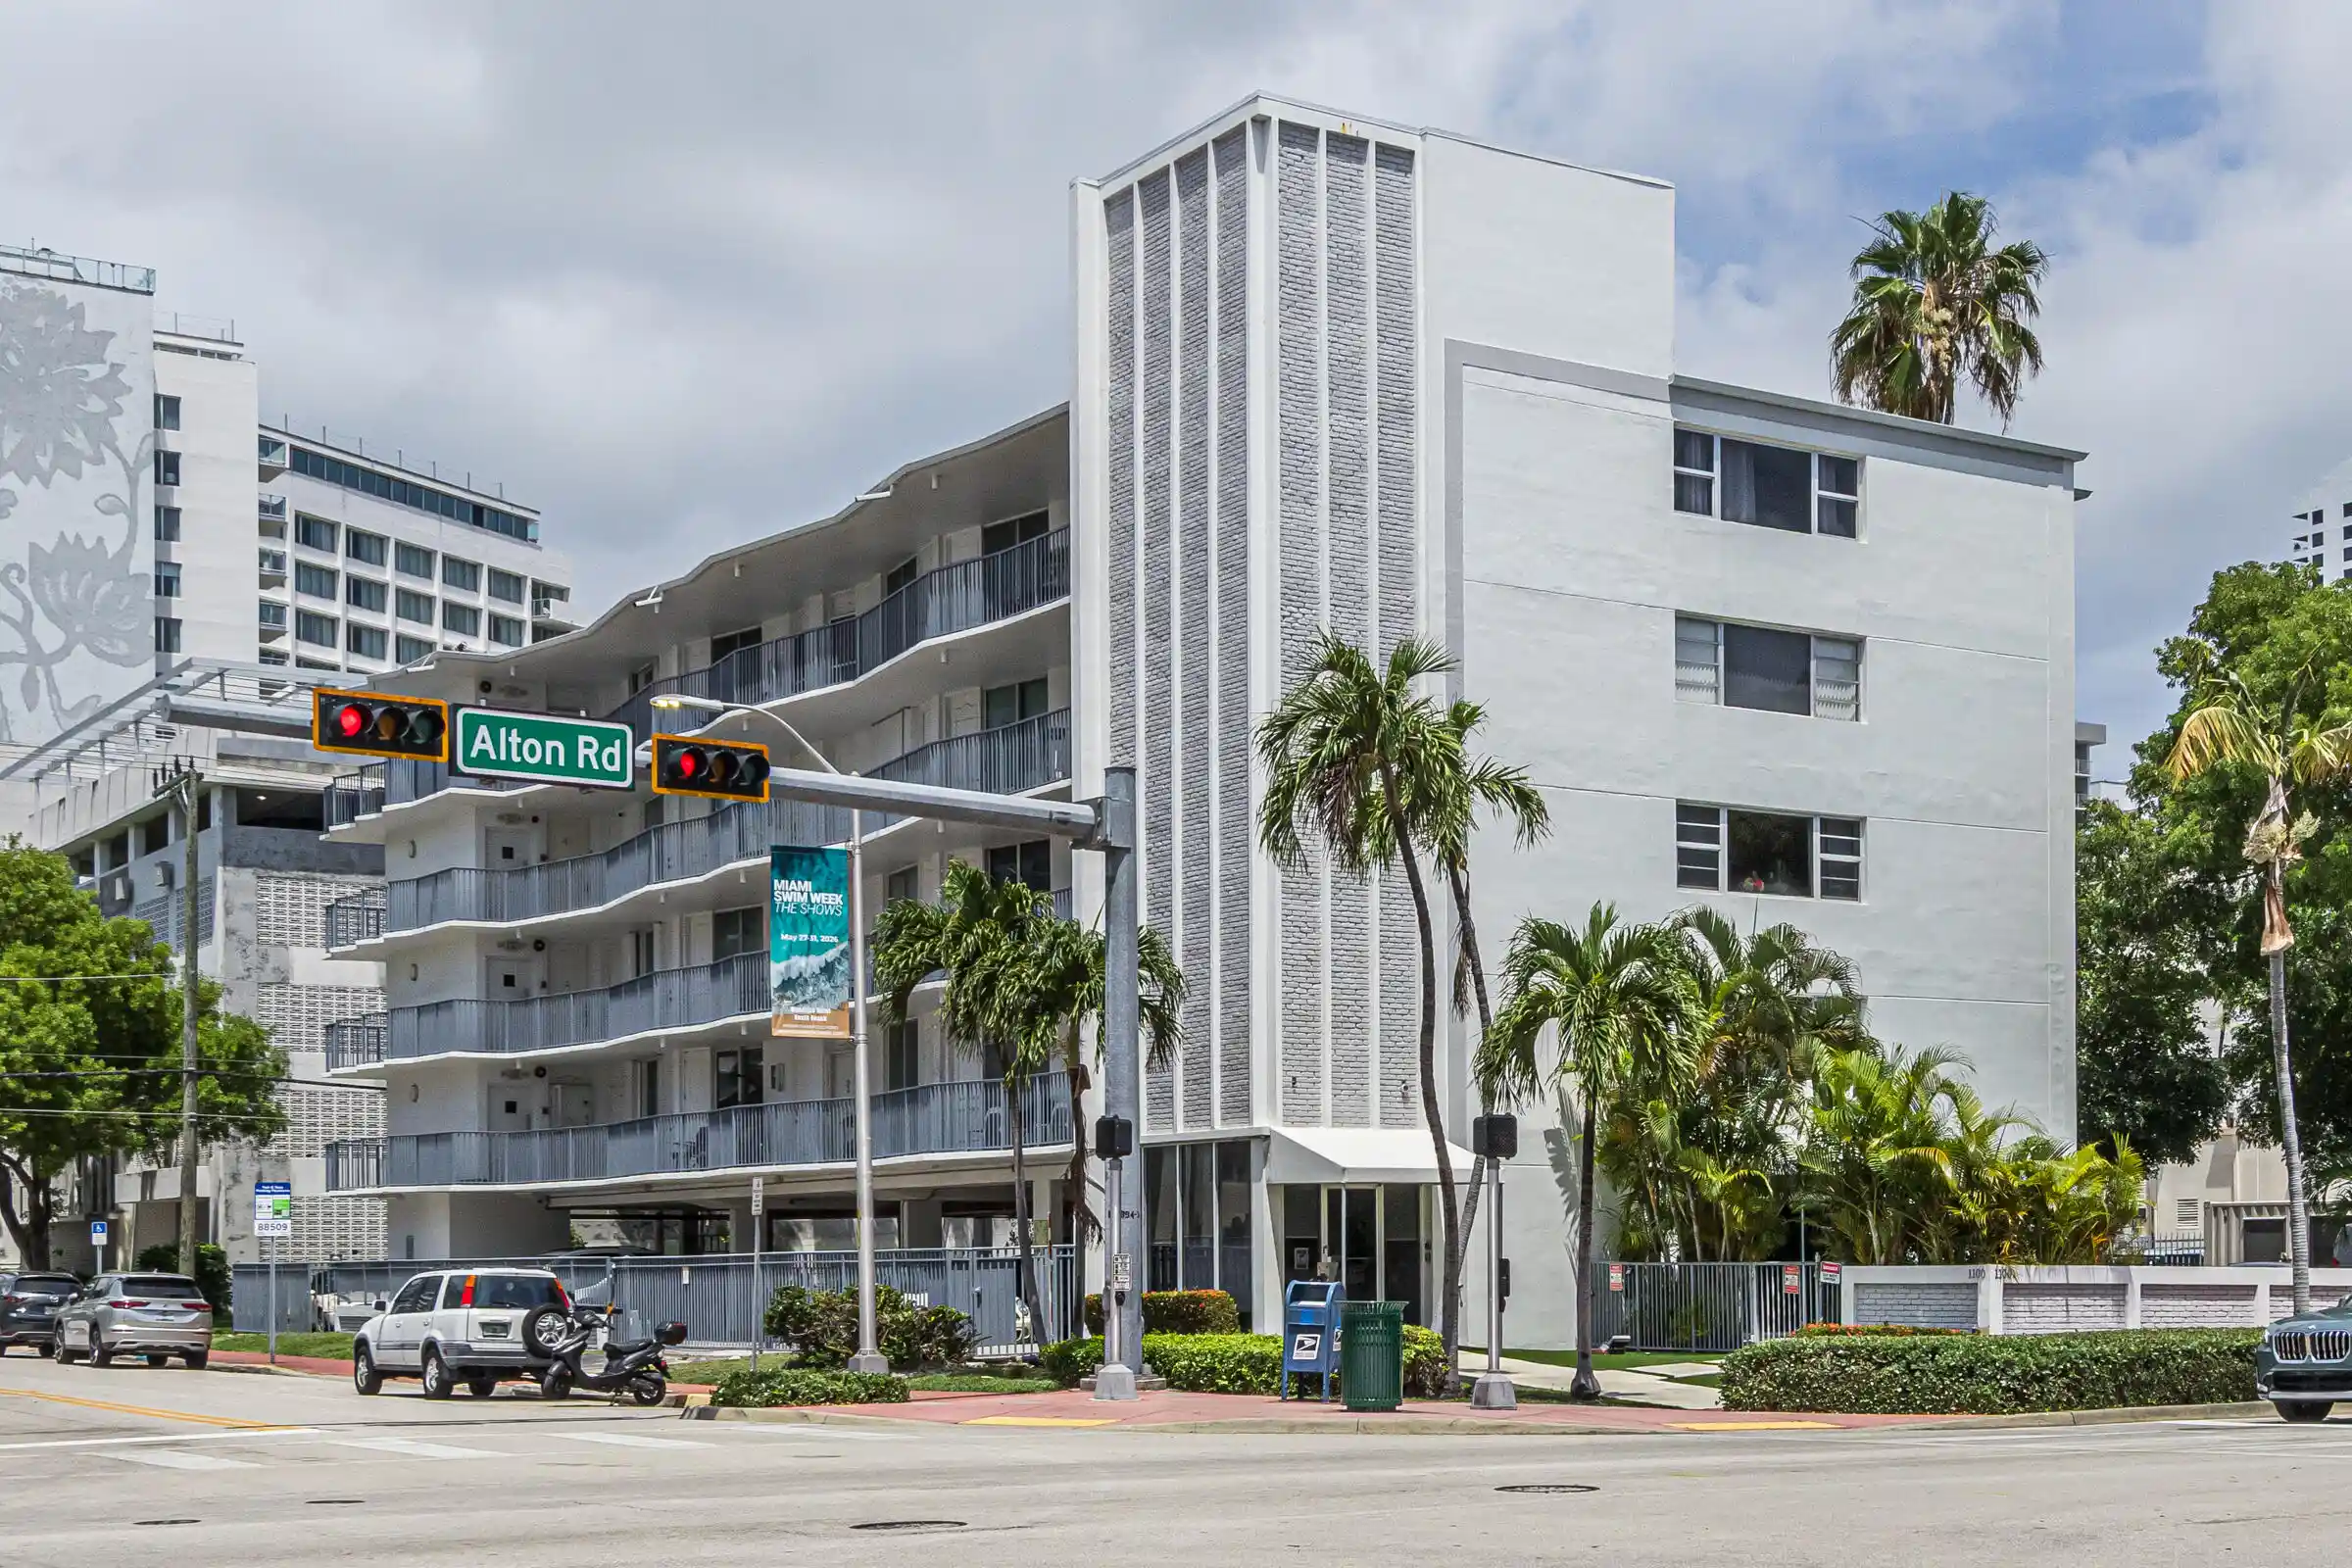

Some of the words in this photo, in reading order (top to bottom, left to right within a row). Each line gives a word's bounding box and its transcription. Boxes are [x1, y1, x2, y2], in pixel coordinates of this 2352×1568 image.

[469, 724, 565, 767] Alton
[577, 734, 621, 772] Rd
[773, 879, 812, 892] MIAMI
[773, 891, 808, 904] SWIM
[809, 892, 844, 906] WEEK
[774, 902, 798, 914] THE
[800, 903, 843, 916] SHOWS
[780, 933, 798, 943] May
[1968, 1268, 1986, 1279] 1100
